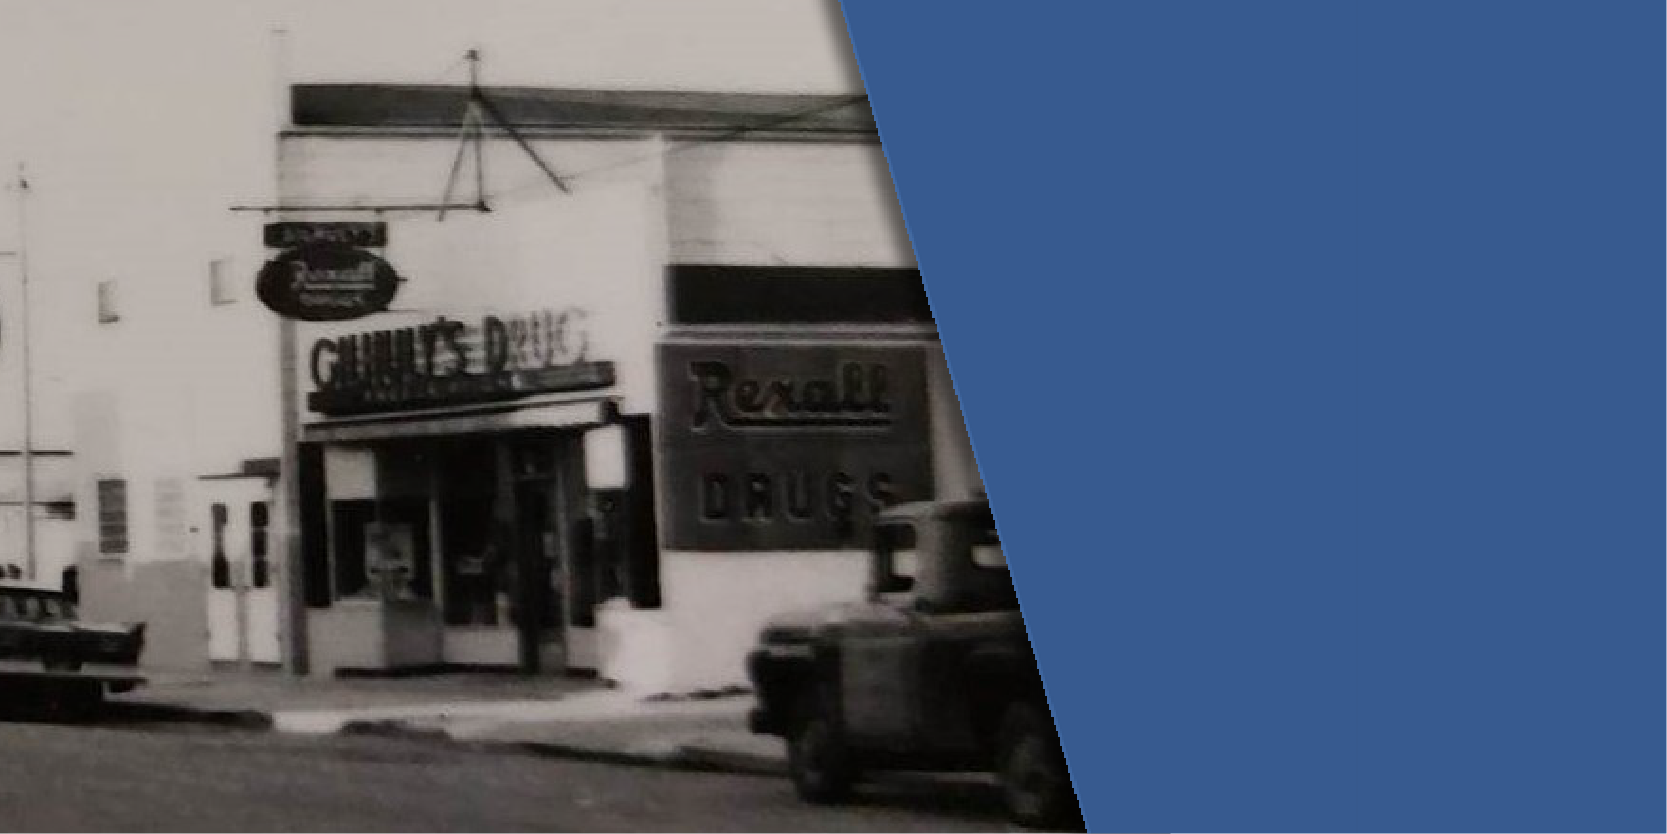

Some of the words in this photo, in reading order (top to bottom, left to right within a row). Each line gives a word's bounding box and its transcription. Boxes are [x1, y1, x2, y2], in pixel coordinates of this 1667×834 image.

[484, 307, 589, 375] DRUG
[688, 361, 893, 434] Rexall
[698, 471, 901, 522] DRUGS
